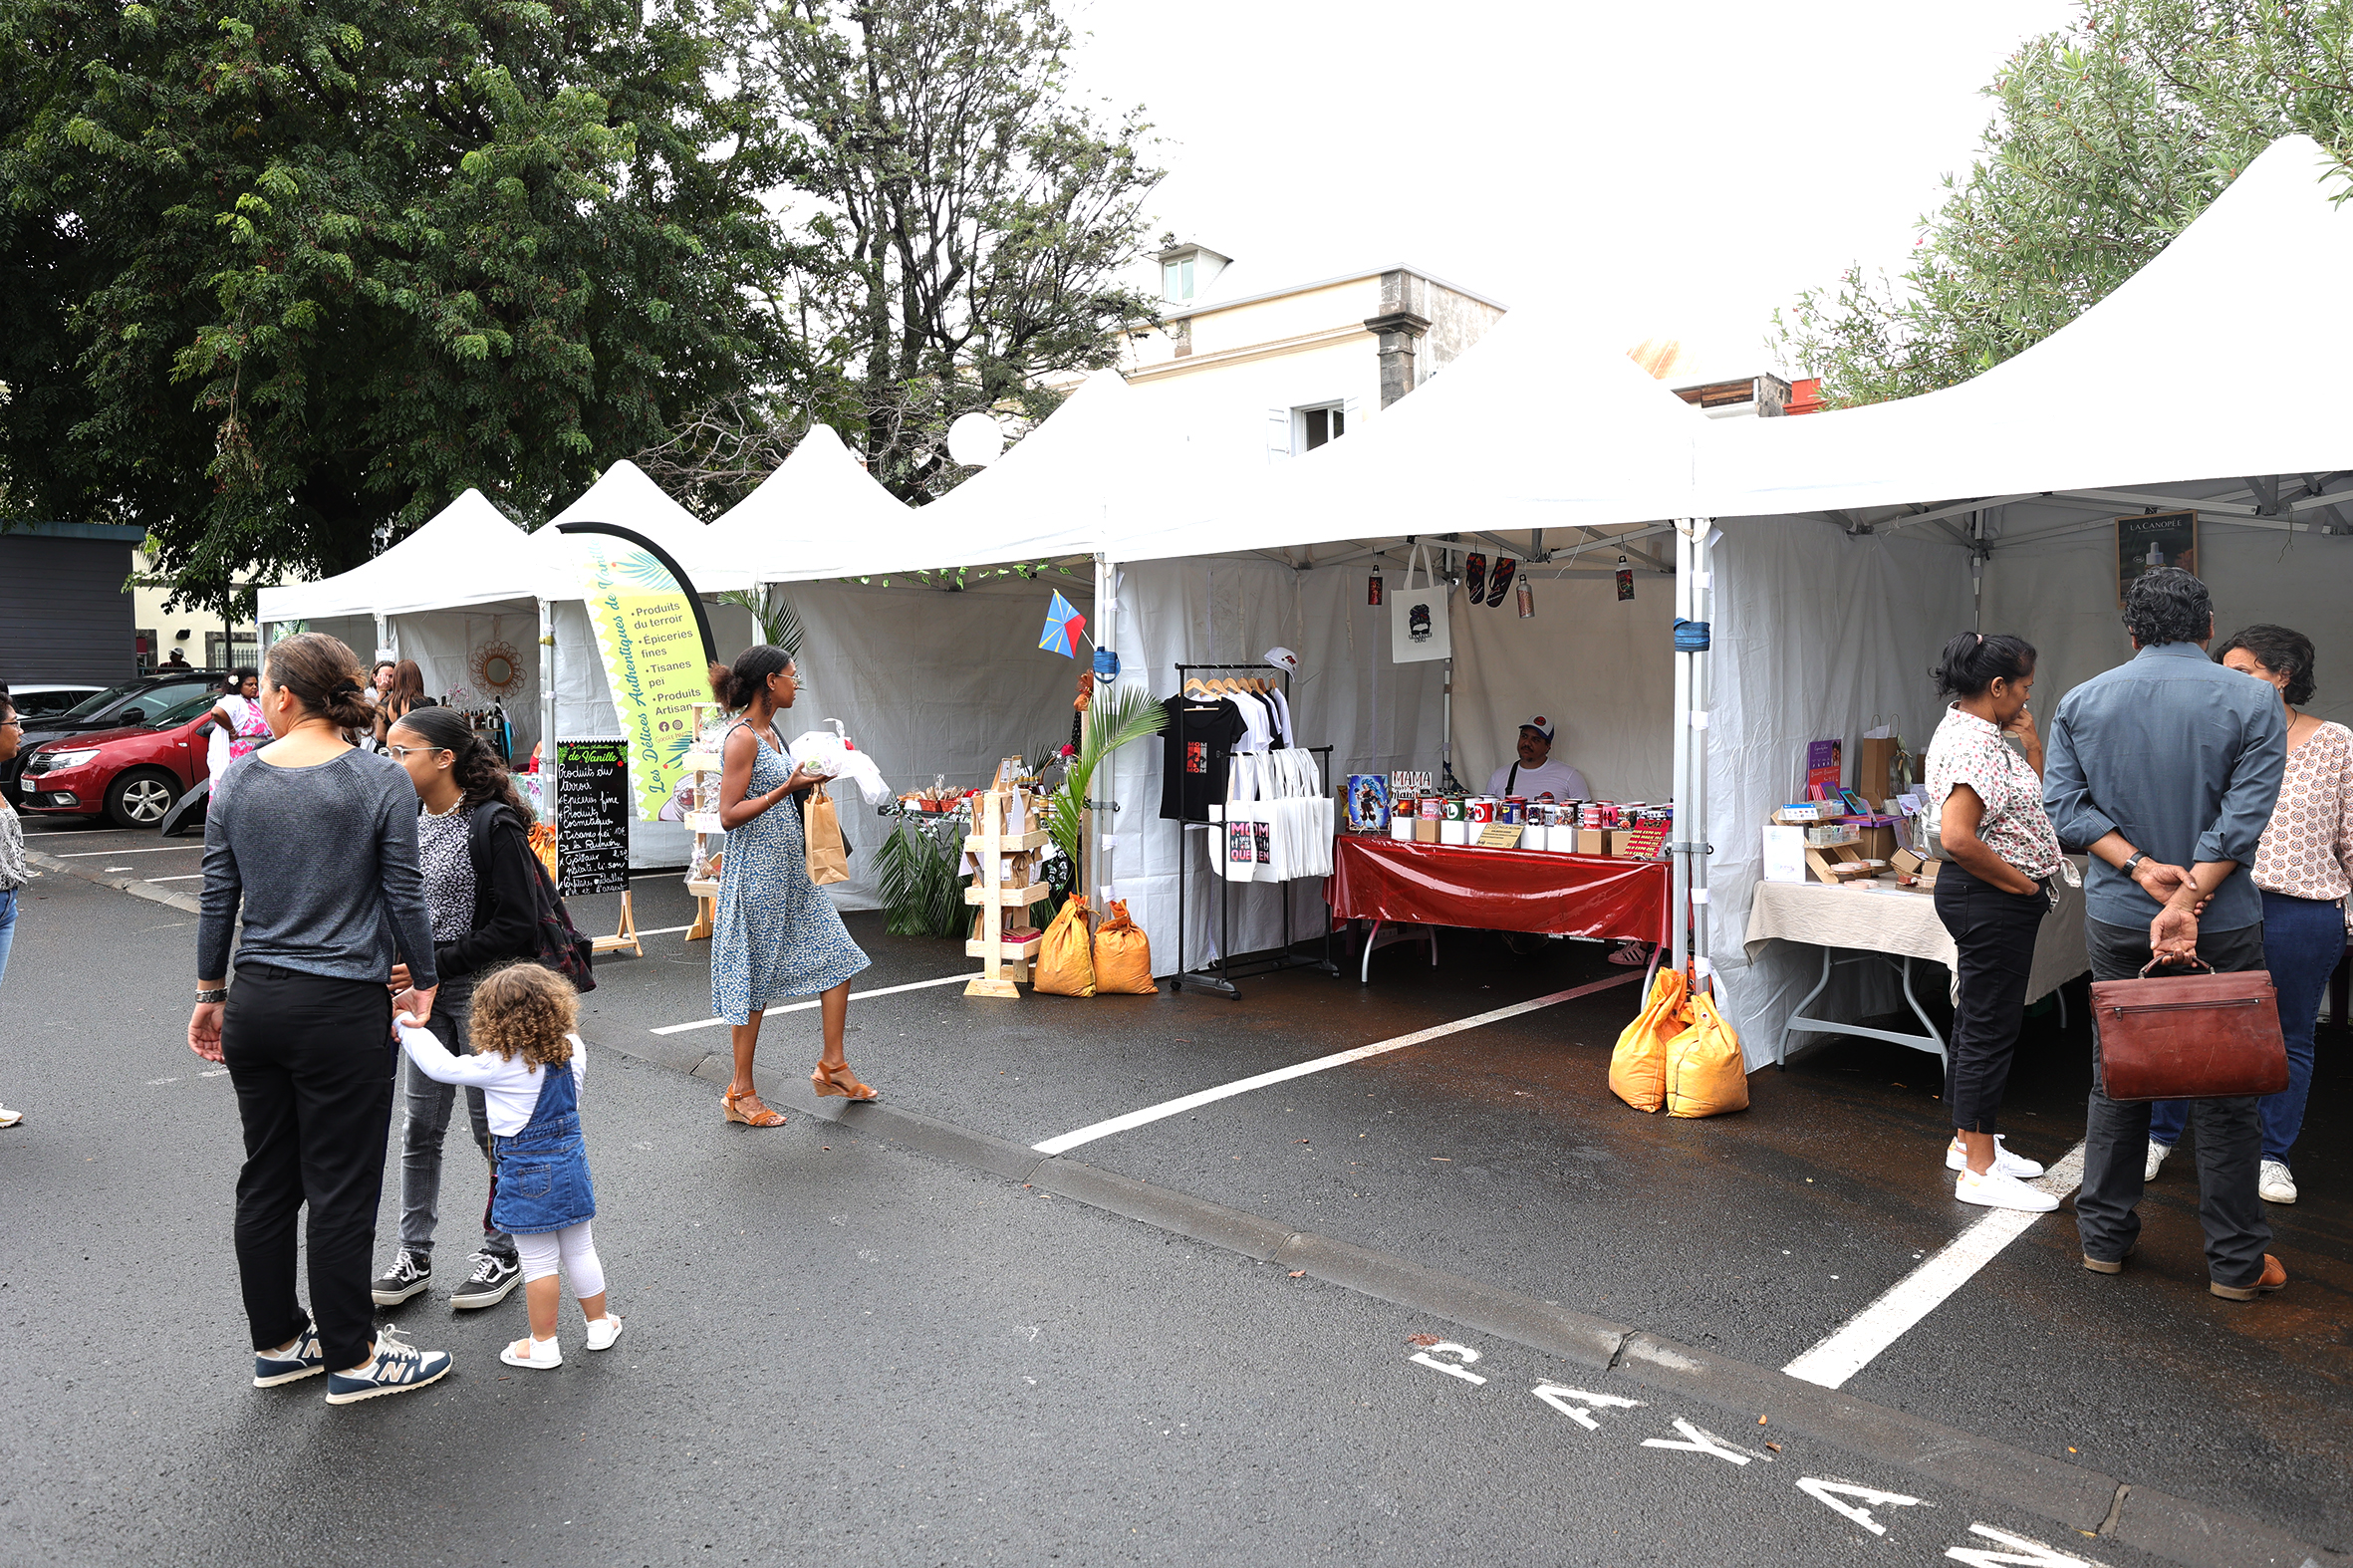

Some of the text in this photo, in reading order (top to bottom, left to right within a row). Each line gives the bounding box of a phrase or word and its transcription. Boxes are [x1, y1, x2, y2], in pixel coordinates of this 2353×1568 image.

[2143, 518, 2183, 530] CANOPÉE
[636, 602, 680, 617] Produits
[634, 614, 683, 630] du terroir
[644, 629, 693, 646] Épiceries
[641, 647, 667, 658] fines
[587, 539, 666, 793] Les Délices Authentiques de Vanille
[651, 659, 692, 673] Tisanes
[649, 676, 665, 689] peï
[656, 687, 701, 702] Produits
[568, 749, 618, 763] de Vanille
[558, 763, 614, 779] Produits du
[1394, 770, 1431, 786] MAMA
[1448, 806, 1455, 816] L
[1474, 807, 1482, 818] M
[378, 1361, 407, 1383] N
